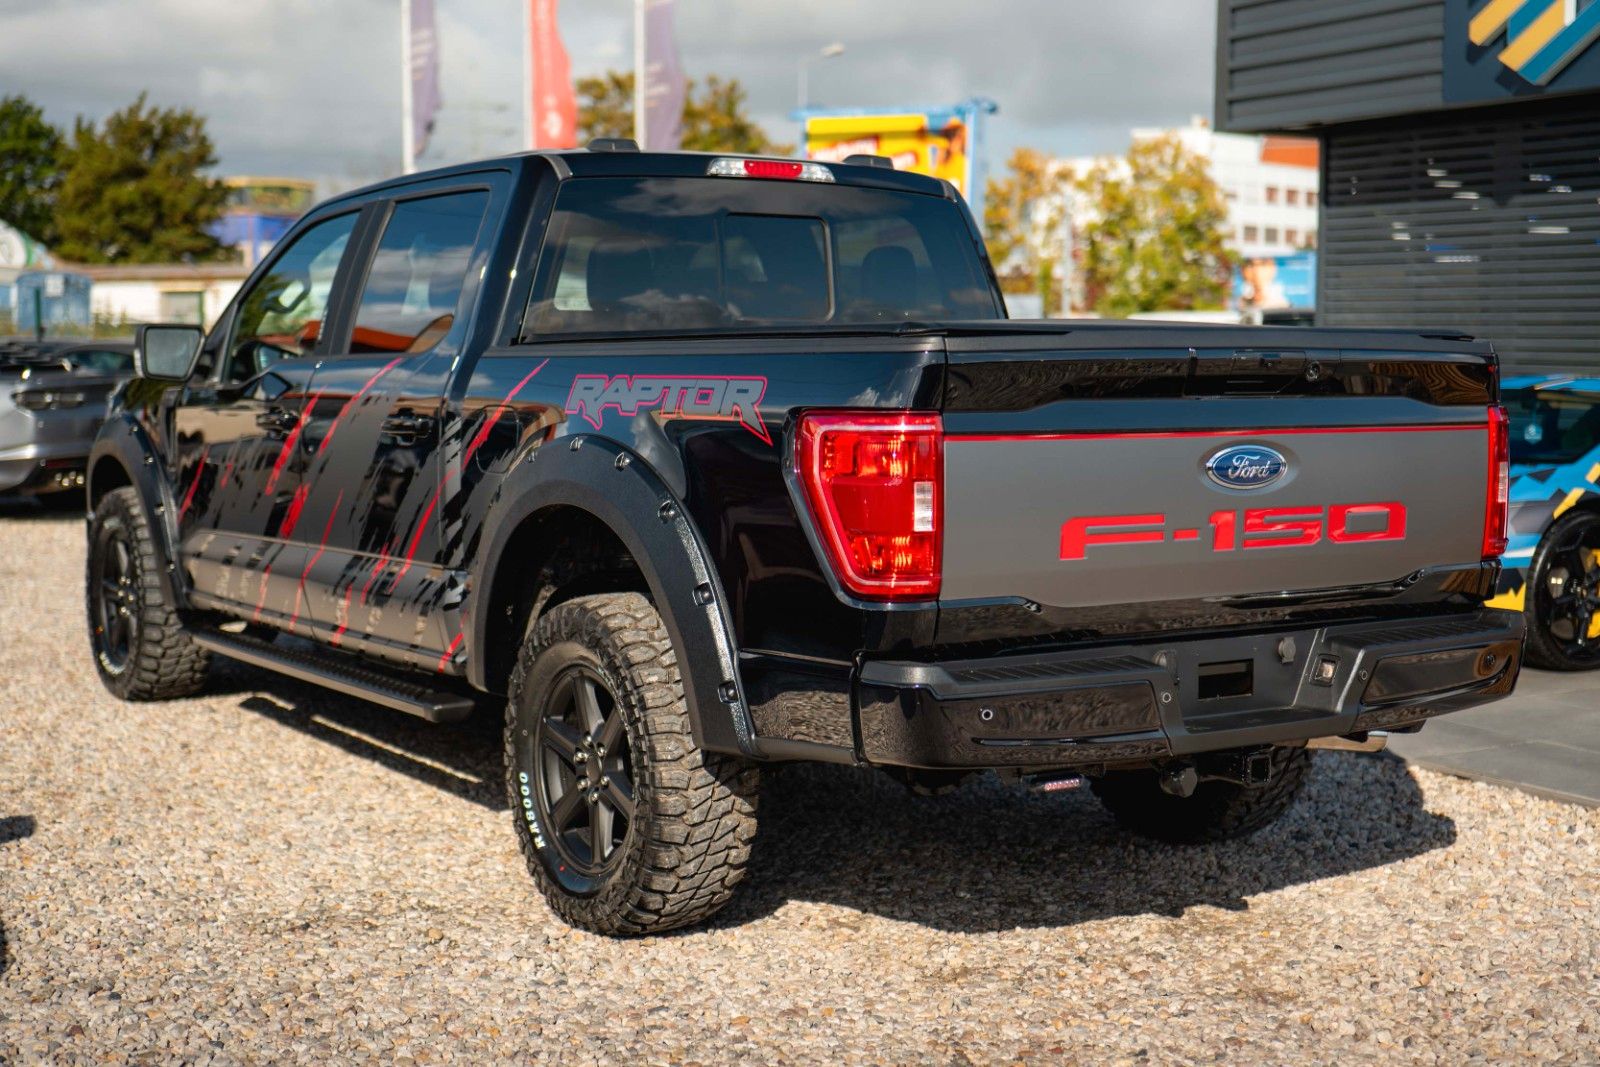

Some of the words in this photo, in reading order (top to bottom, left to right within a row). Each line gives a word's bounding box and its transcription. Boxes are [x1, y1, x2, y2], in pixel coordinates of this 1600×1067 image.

[565, 375, 773, 446] RAPTOR
[1227, 454, 1272, 480] Ford
[1059, 502, 1406, 560] F-150
